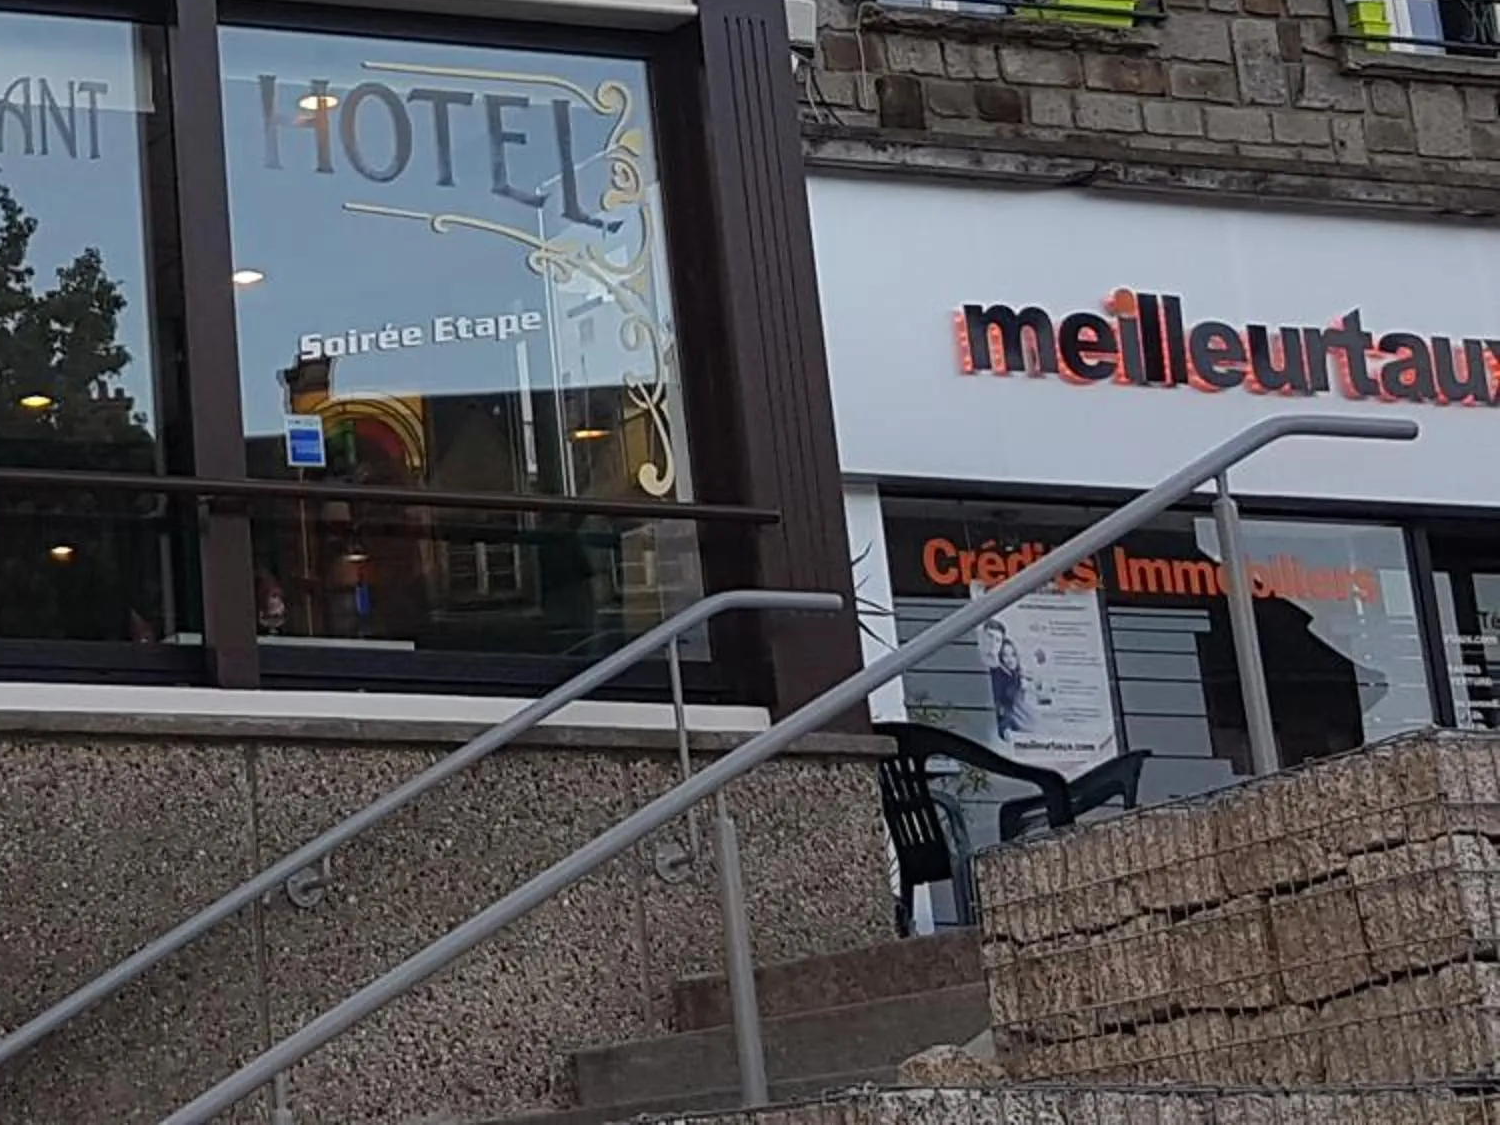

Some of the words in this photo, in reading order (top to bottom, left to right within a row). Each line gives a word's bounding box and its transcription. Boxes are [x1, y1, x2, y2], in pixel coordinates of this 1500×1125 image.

[257, 73, 625, 234] HOTEL
[299, 322, 424, 361] Soirée
[432, 310, 542, 342] Etape
